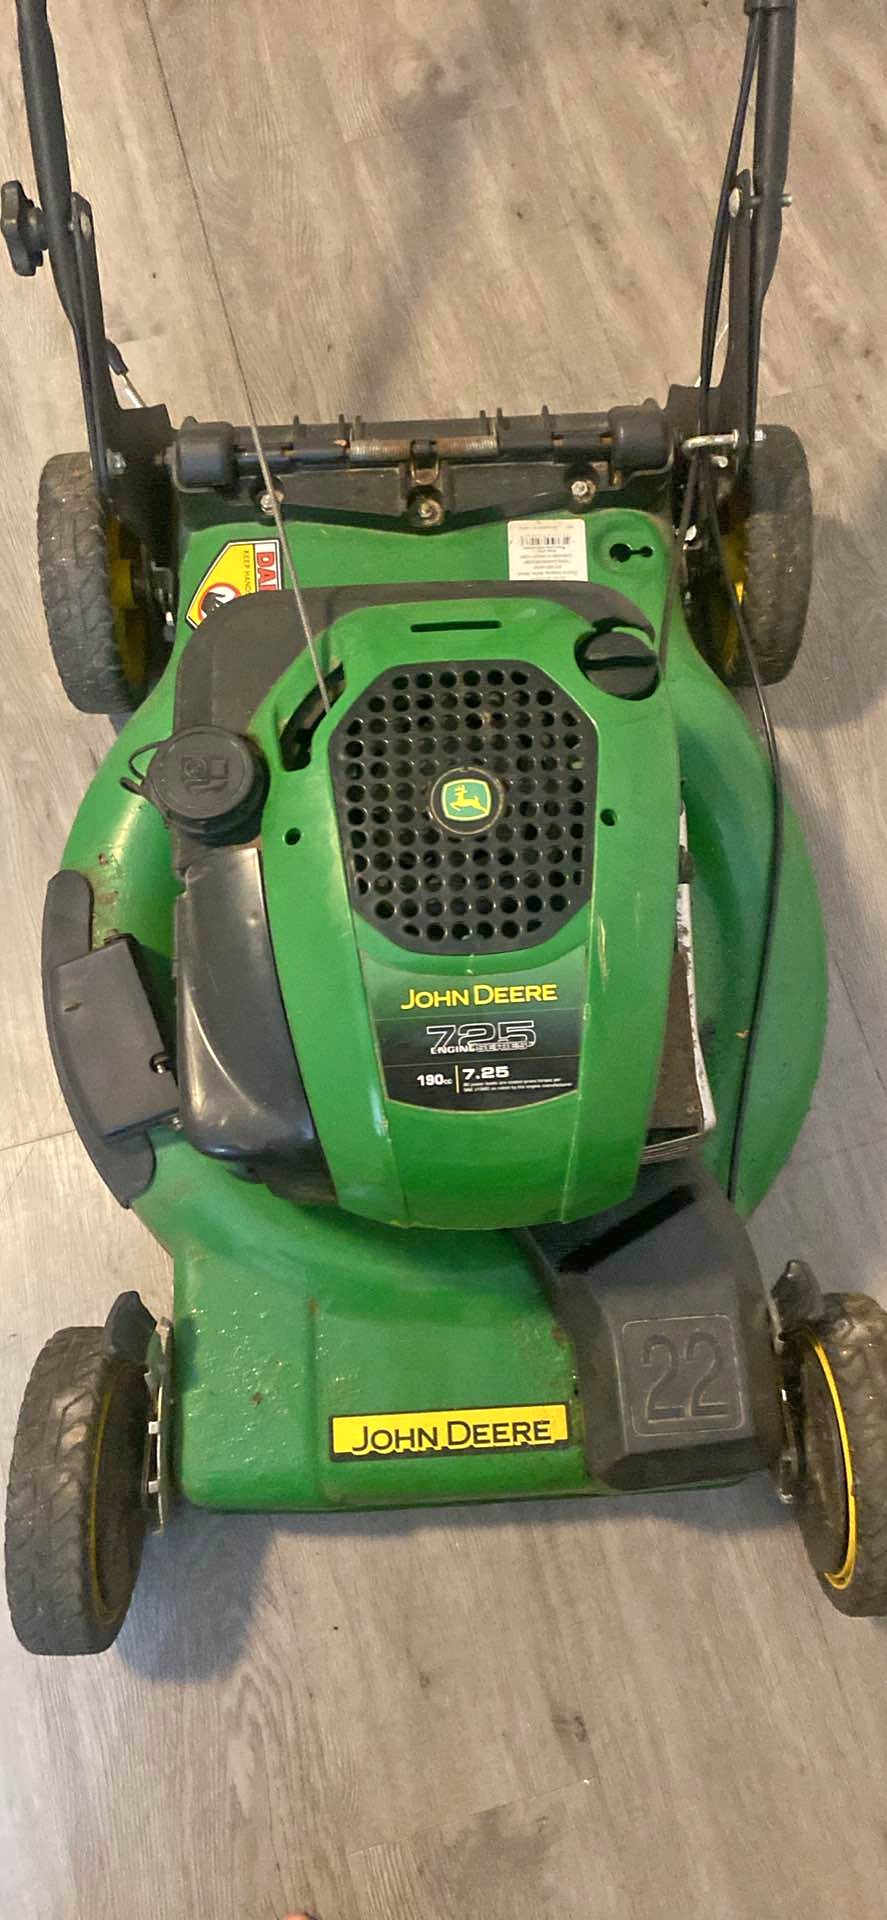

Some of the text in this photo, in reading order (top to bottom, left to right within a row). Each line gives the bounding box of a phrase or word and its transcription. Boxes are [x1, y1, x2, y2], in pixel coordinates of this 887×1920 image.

[401, 984, 558, 1009] JOHN DEERE
[426, 1020, 537, 1050] 725
[430, 1044, 475, 1054] ENGINE
[462, 1066, 510, 1080] 7.25
[641, 1331, 730, 1424] 22
[352, 1419, 551, 1452] JOHN DEERE
